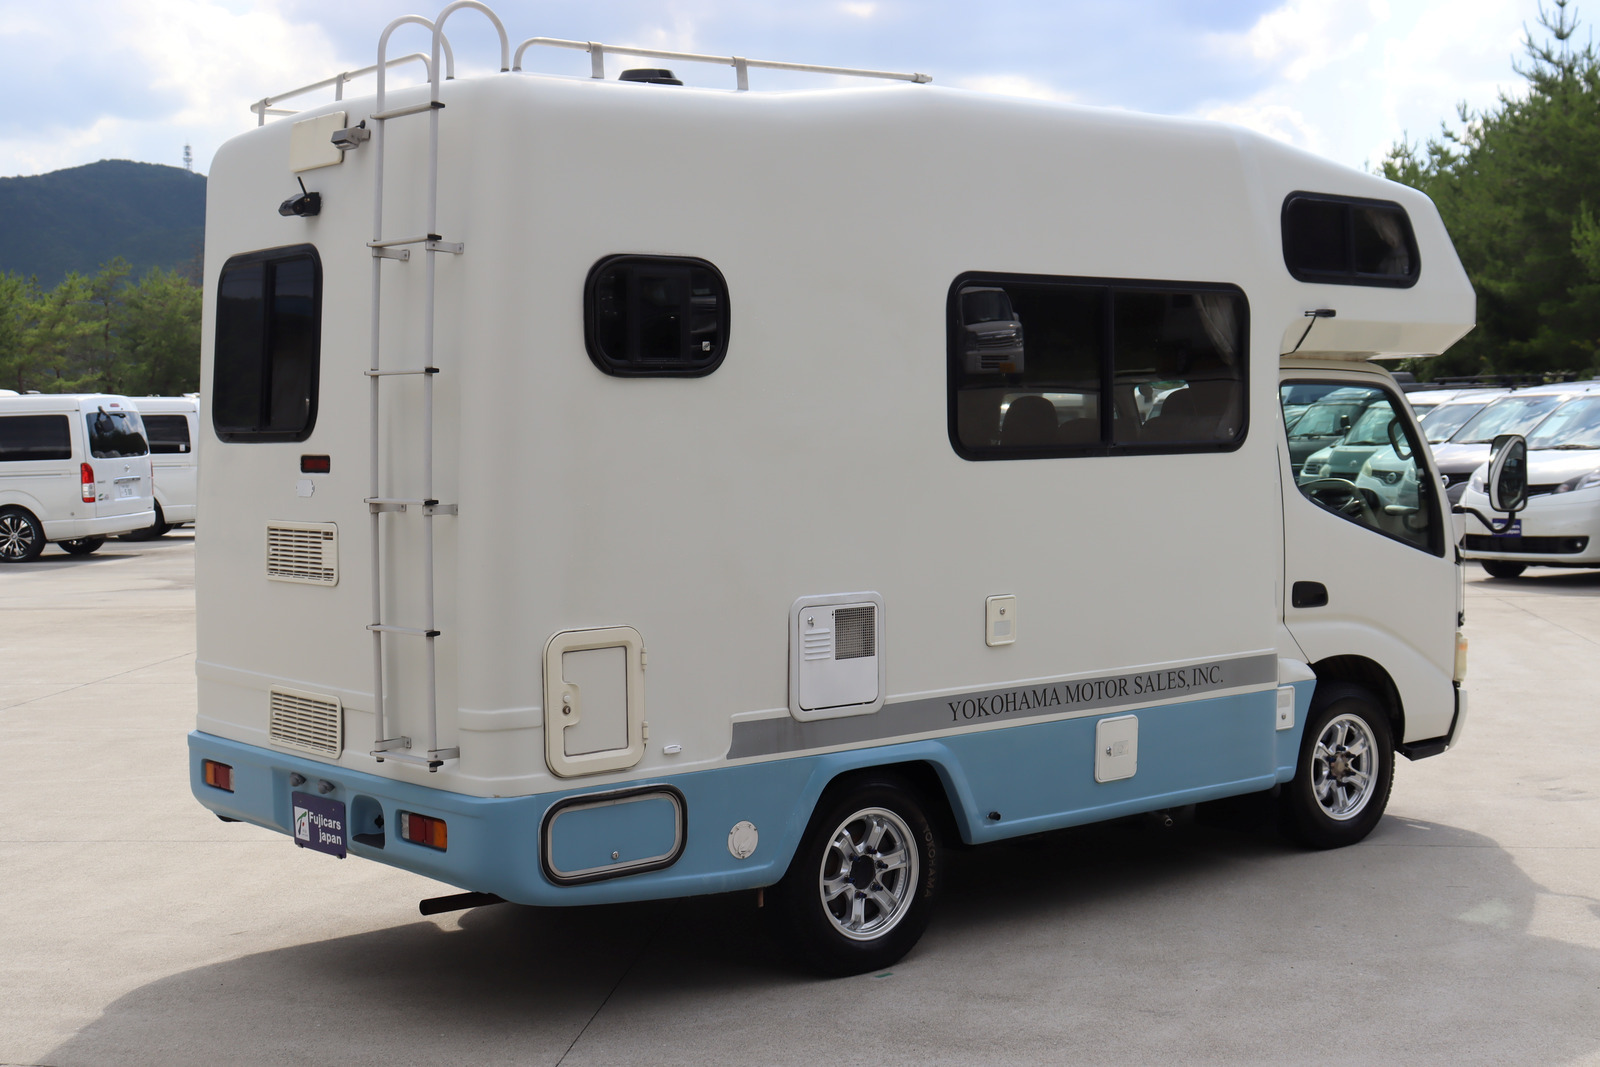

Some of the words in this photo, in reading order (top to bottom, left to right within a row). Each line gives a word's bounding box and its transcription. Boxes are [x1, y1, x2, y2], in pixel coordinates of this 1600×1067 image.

[947, 687, 1061, 722] YOKOHAMA
[1065, 677, 1129, 705] MOTOR
[309, 811, 342, 831] Fujicars
[318, 828, 342, 846] japan
[923, 823, 936, 898] YOKOHAMA
